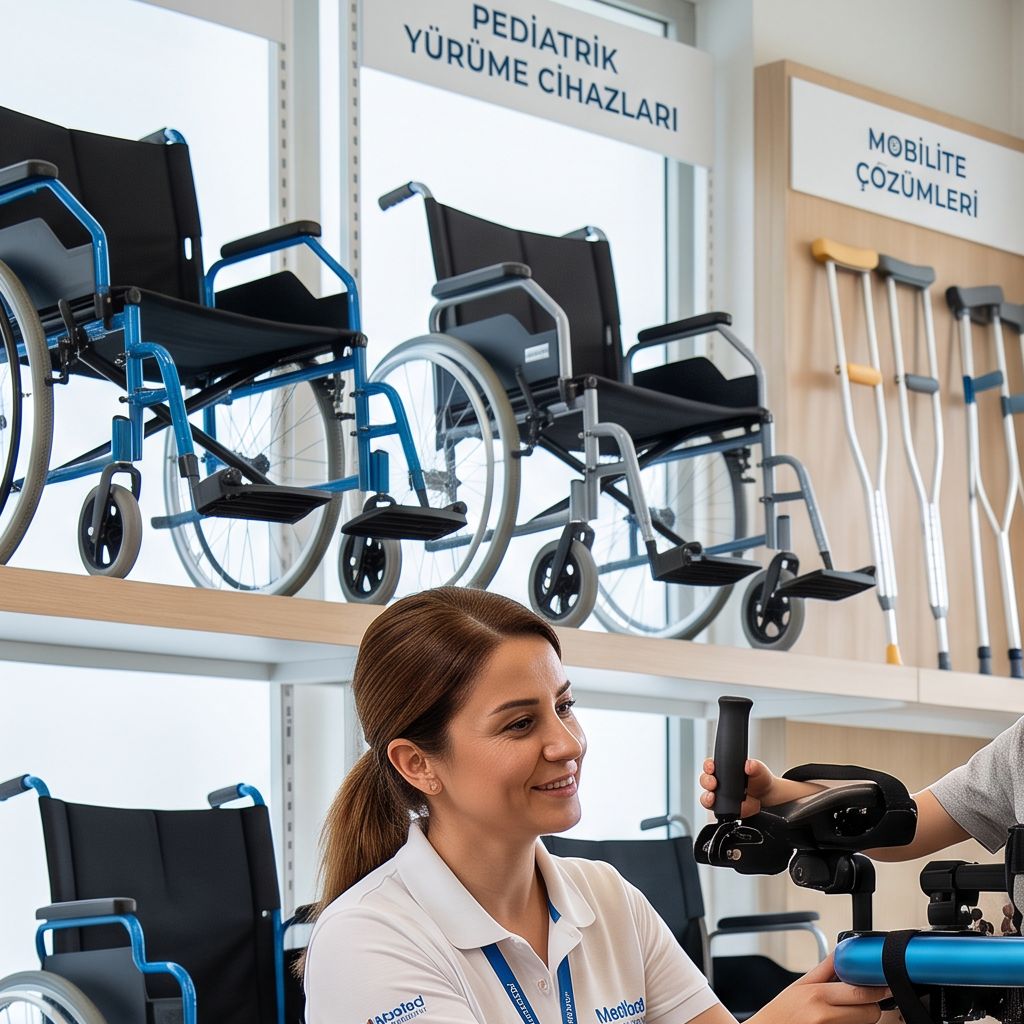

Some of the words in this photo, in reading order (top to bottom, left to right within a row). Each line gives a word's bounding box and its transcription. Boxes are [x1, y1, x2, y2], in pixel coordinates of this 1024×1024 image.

[473, 3, 619, 75] PEDİATRİK
[403, 23, 529, 87] YÜRÜME
[538, 63, 679, 132] CİHAZLARI
[868, 127, 967, 179] MOBİLİTE
